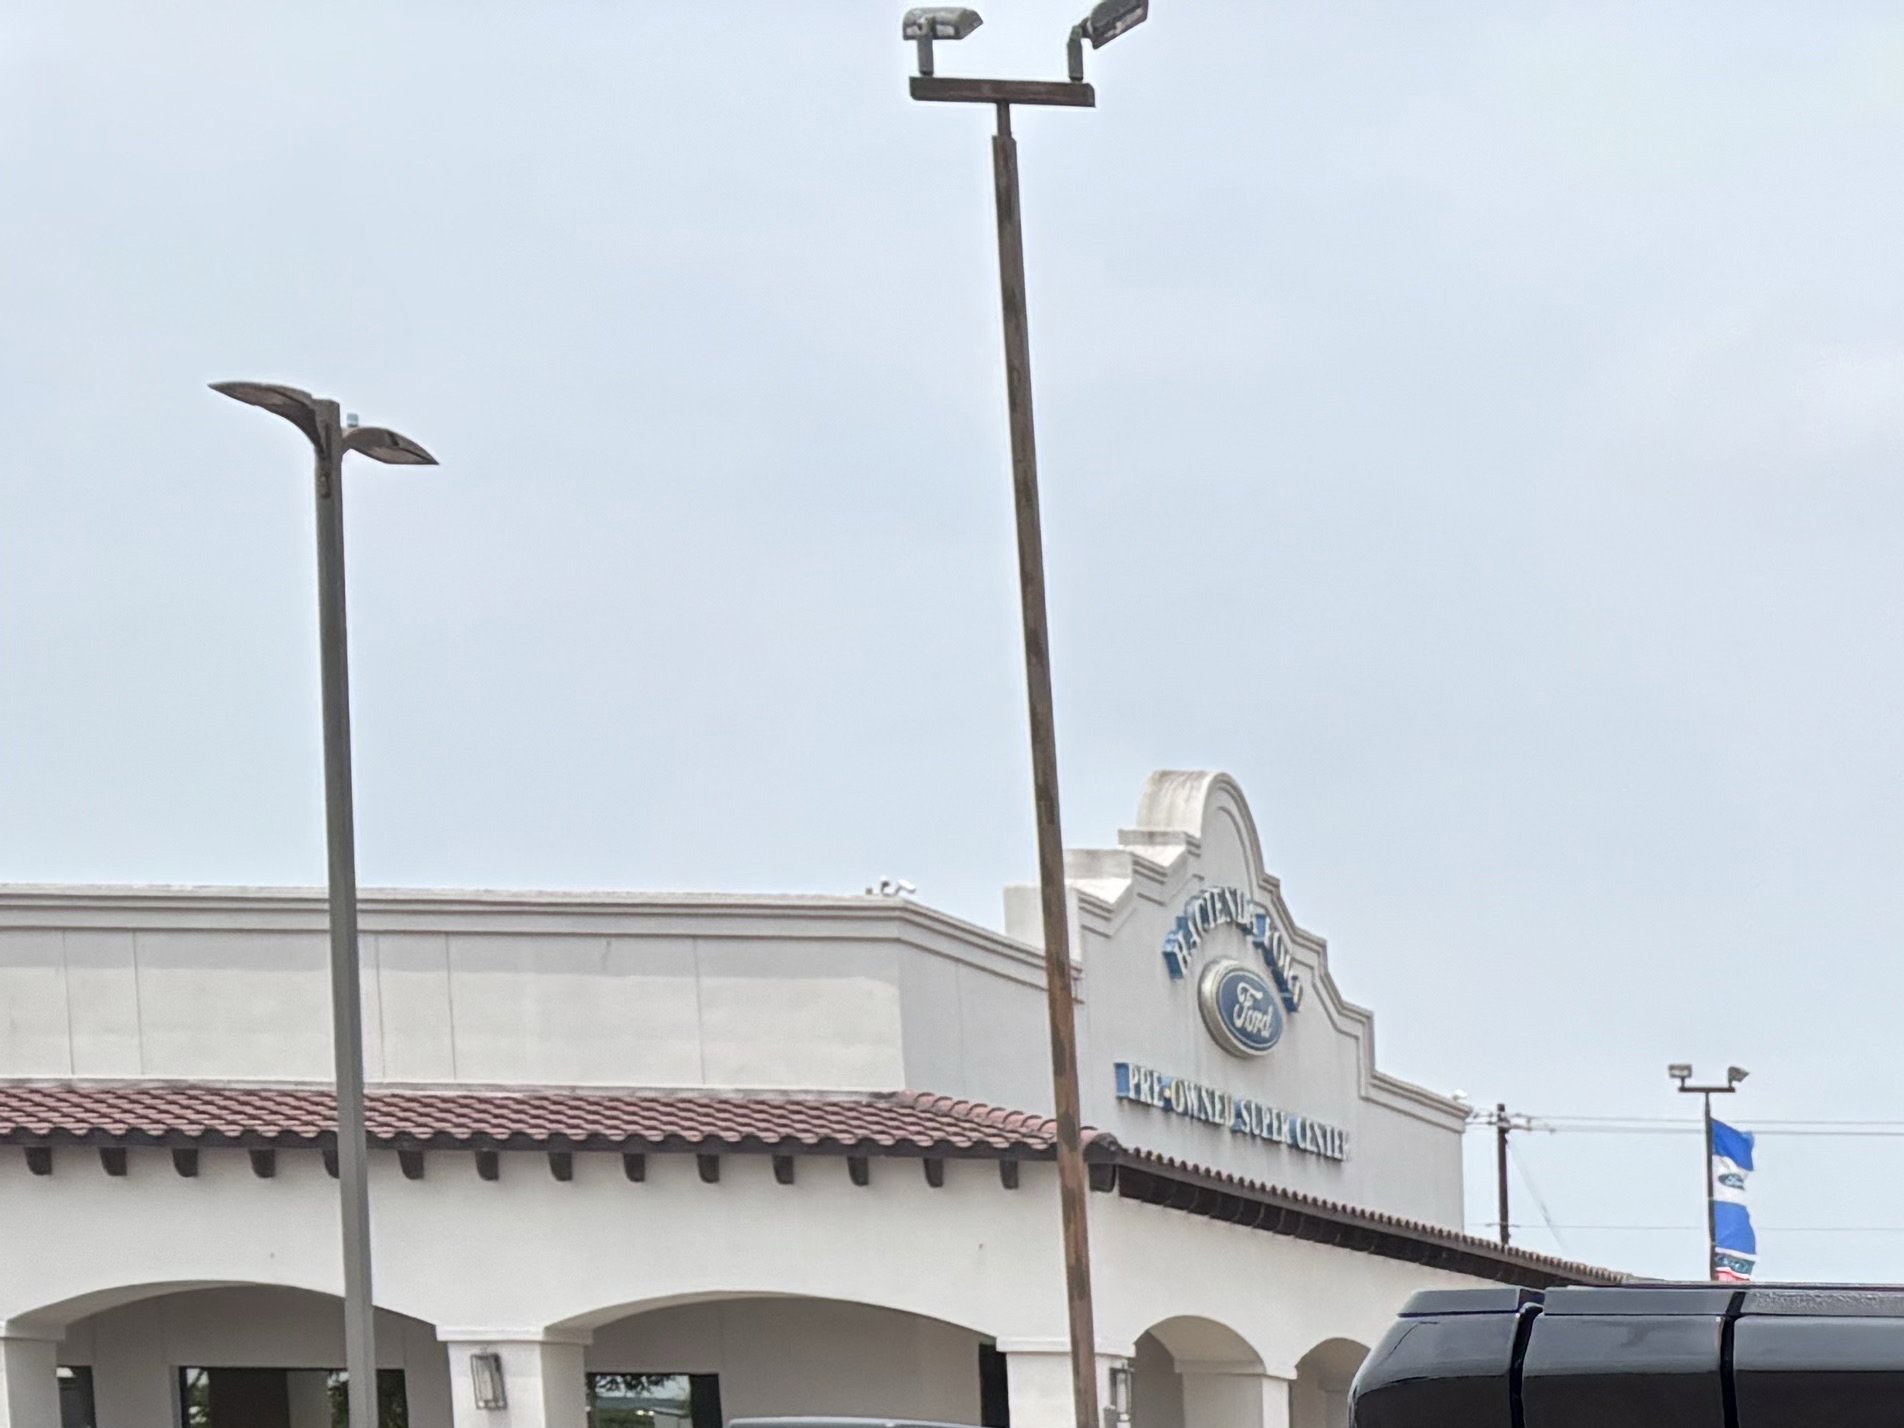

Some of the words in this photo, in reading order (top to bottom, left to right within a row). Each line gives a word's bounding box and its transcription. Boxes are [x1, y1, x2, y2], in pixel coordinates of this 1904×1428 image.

[1163, 885, 1258, 979] HACIENDA
[1232, 980, 1273, 1038] Ford
[1232, 1096, 1292, 1146] SUPER
[1290, 1116, 1351, 1162] CENTER
